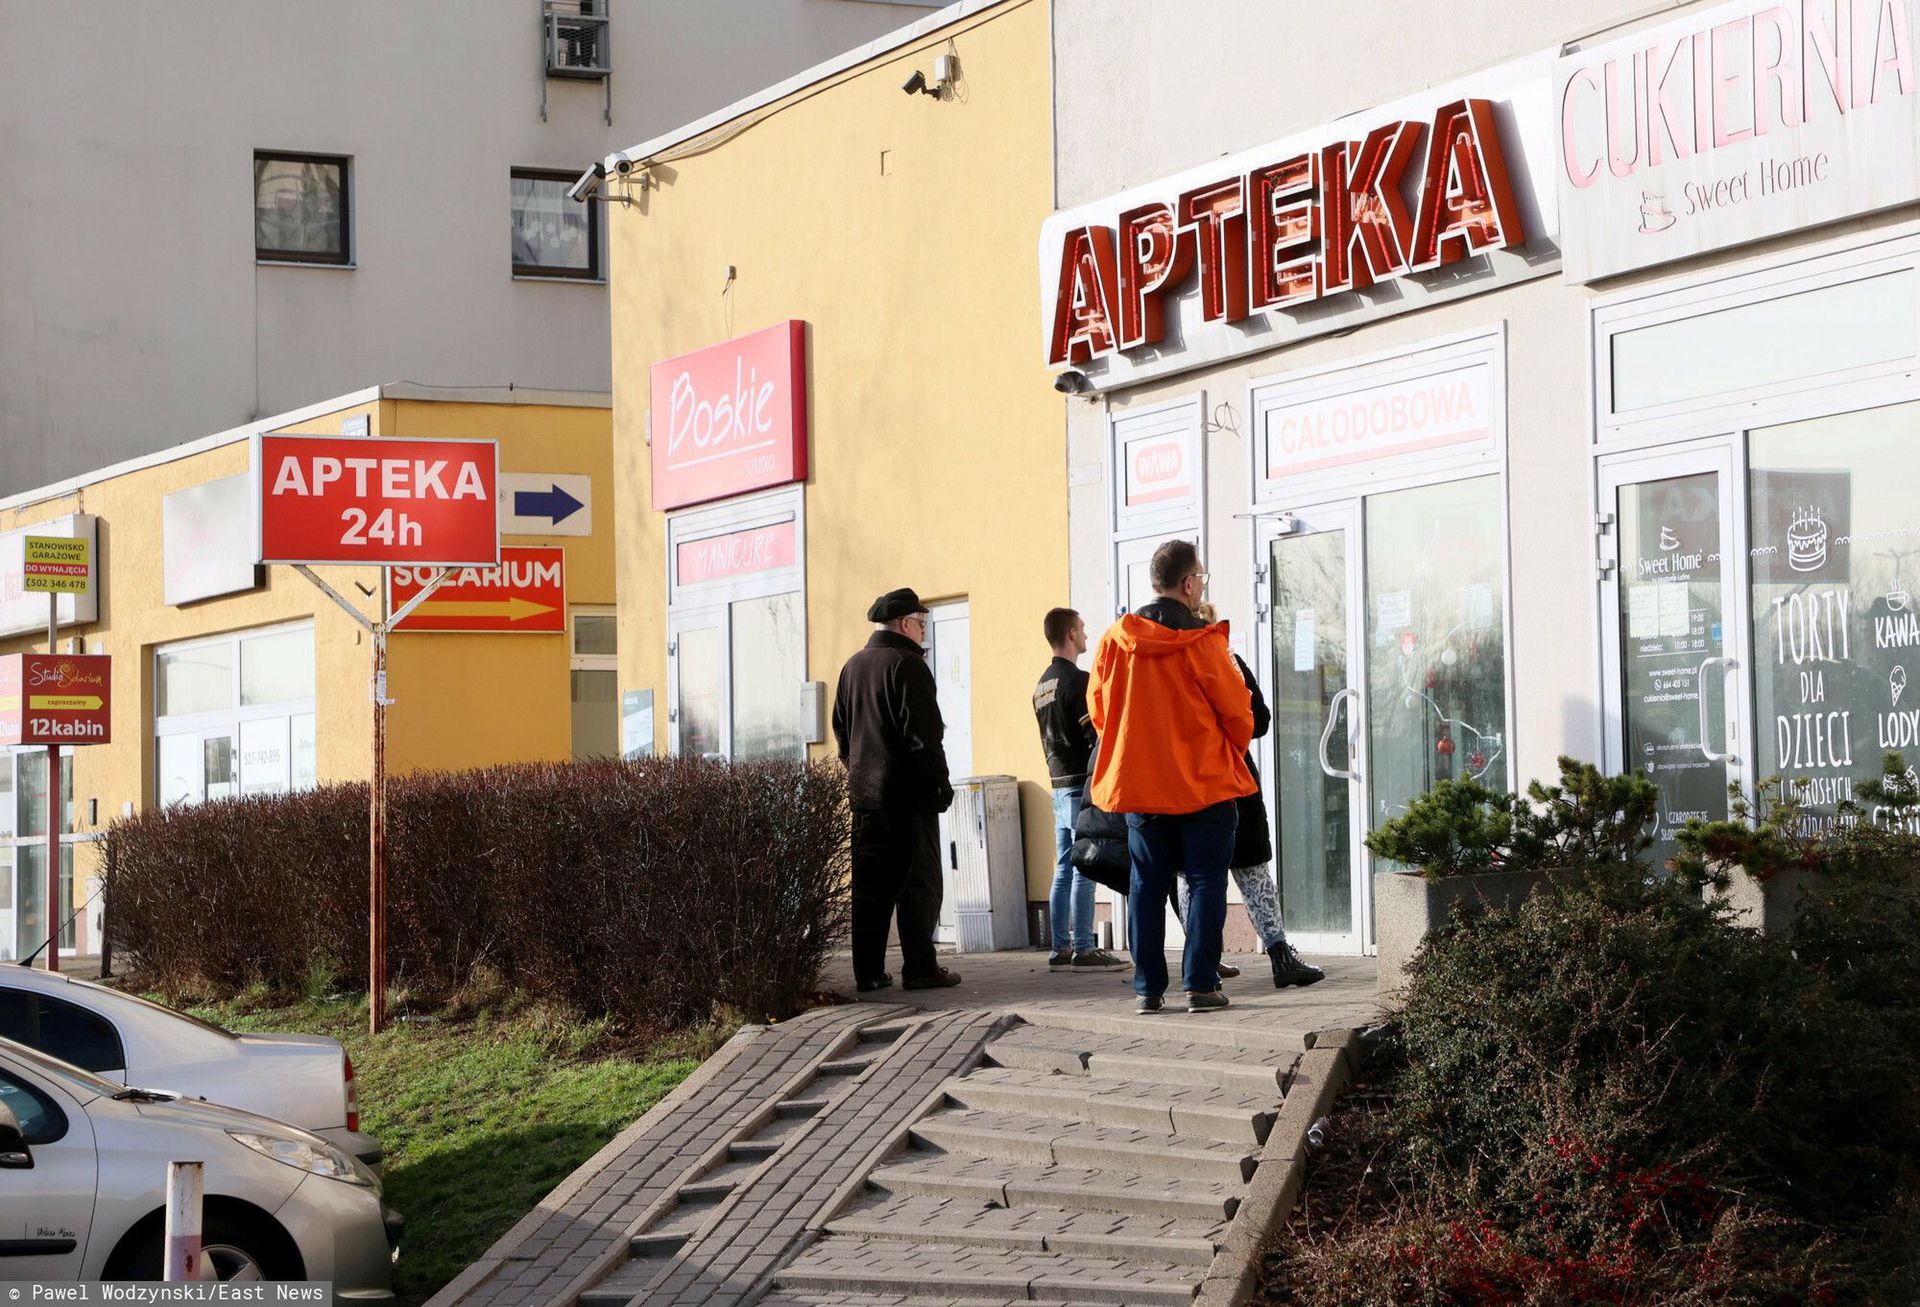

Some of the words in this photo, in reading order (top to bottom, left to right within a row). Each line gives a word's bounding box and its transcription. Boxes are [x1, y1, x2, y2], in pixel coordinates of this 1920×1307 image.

[1561, 0, 1917, 189] CUKIERNIA
[1683, 168, 1751, 216] Sweet
[1759, 152, 1829, 197] Home
[1049, 98, 1526, 367] APTEKA
[667, 355, 775, 457] Boskie
[1280, 382, 1475, 454] CAŁODOBOWA
[272, 456, 487, 501] APTEKA
[744, 455, 776, 475] STUDIO
[29, 541, 84, 551] STANOWISKO
[340, 507, 423, 547] 24h
[26, 564, 36, 572] DO
[40, 566, 86, 575] WYNAJĘCIA
[32, 550, 80, 560] GARAŻOWE
[696, 531, 775, 575] MANICURE
[1638, 557, 1669, 575] Sweet
[1671, 553, 1702, 572] Home
[31, 579, 47, 587] 502
[50, 580, 67, 588] 346
[69, 580, 86, 589] 478
[1772, 589, 1849, 666] TORTY
[1875, 613, 1920, 649] KAWA
[30, 662, 63, 686] Studio
[1800, 670, 1825, 704] DLA
[1777, 710, 1853, 769] DZIECI
[1878, 708, 1920, 748] LODY
